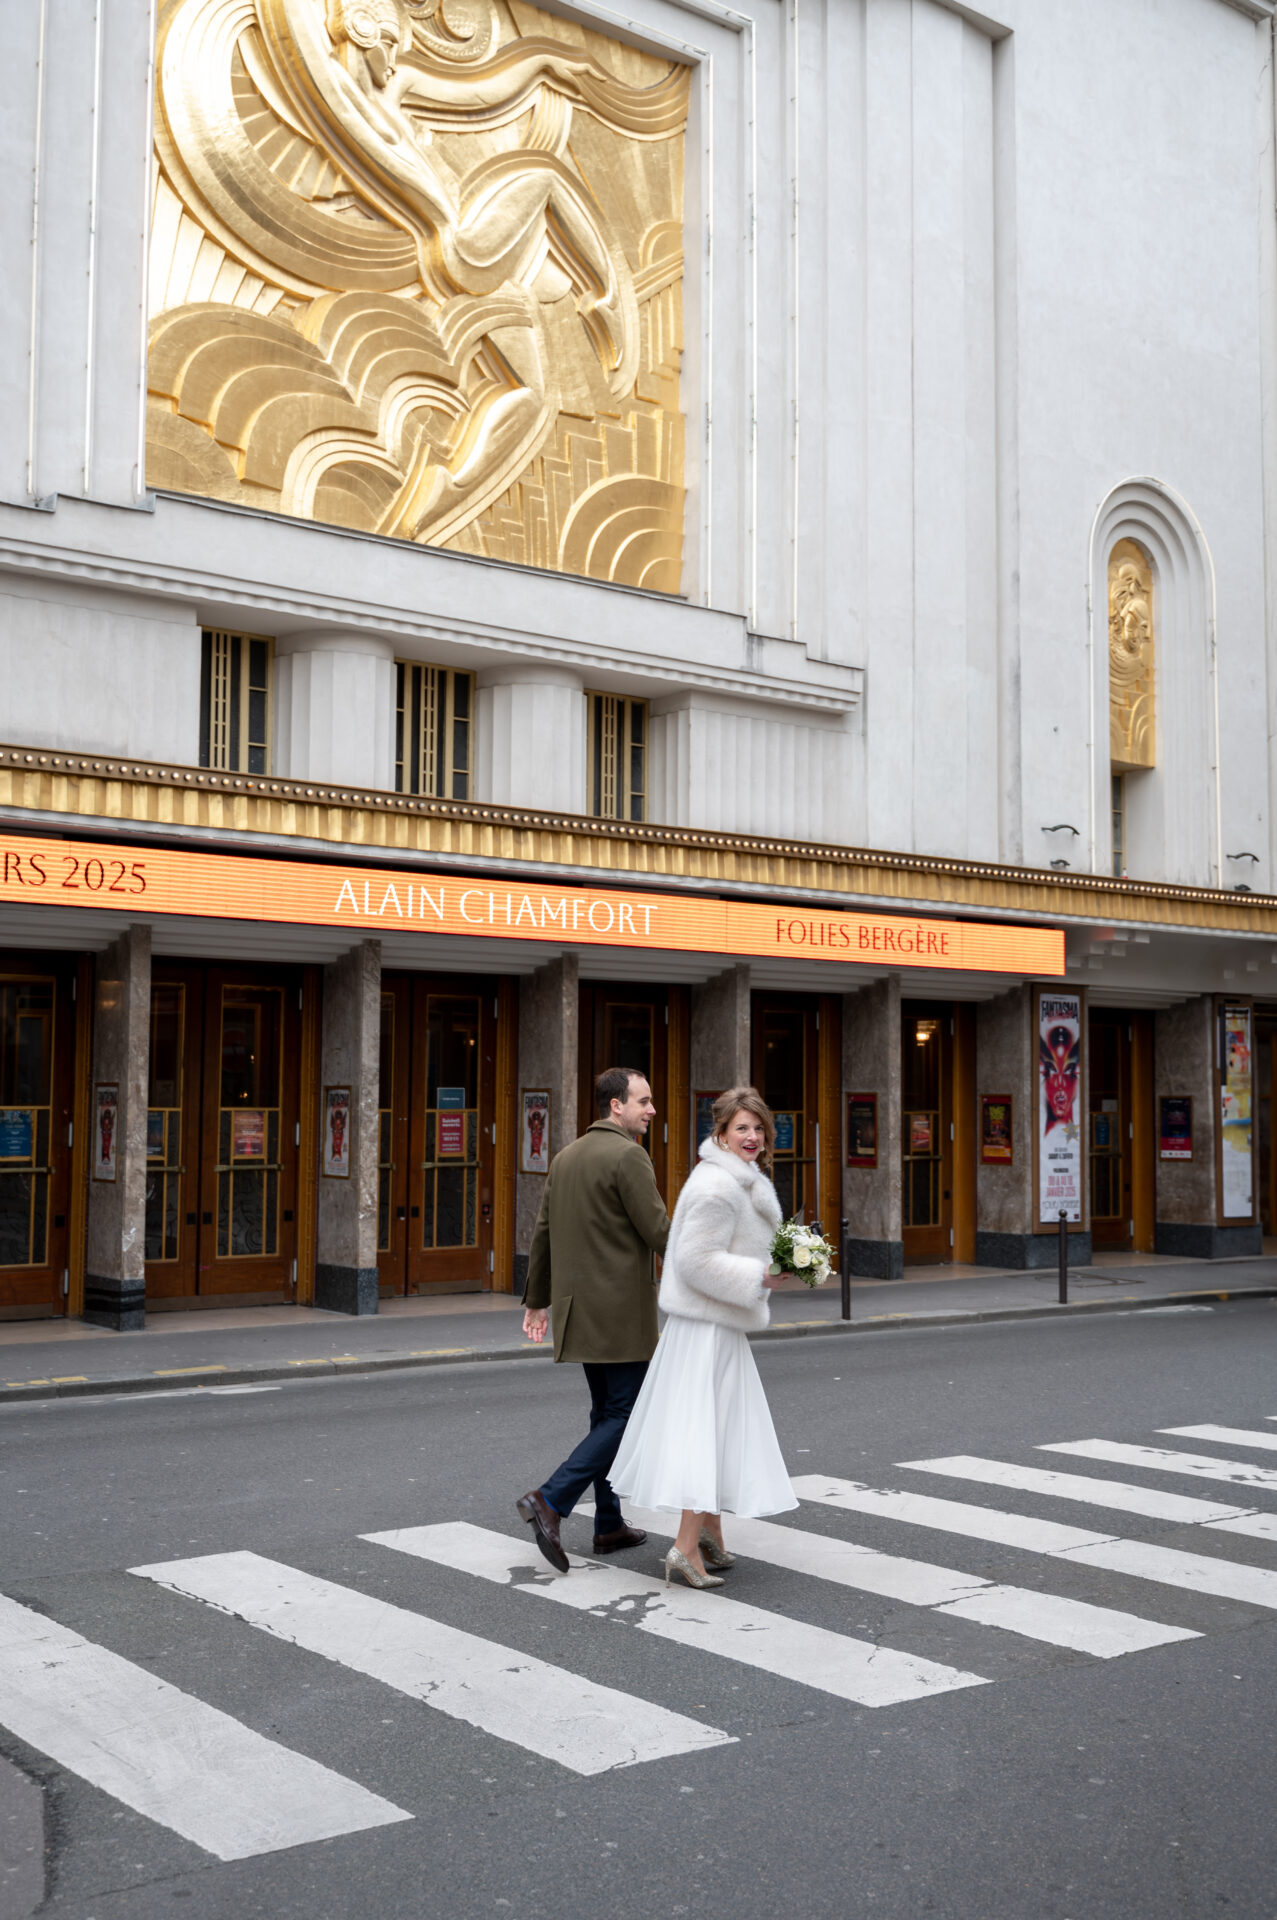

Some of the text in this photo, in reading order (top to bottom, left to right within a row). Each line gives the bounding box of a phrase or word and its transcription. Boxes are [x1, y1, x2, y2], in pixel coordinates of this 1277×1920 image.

[62, 856, 147, 894] 2025
[334, 879, 659, 935] ALAIN CHAMFORT
[776, 919, 950, 956] FOLIES BERGÈRE
